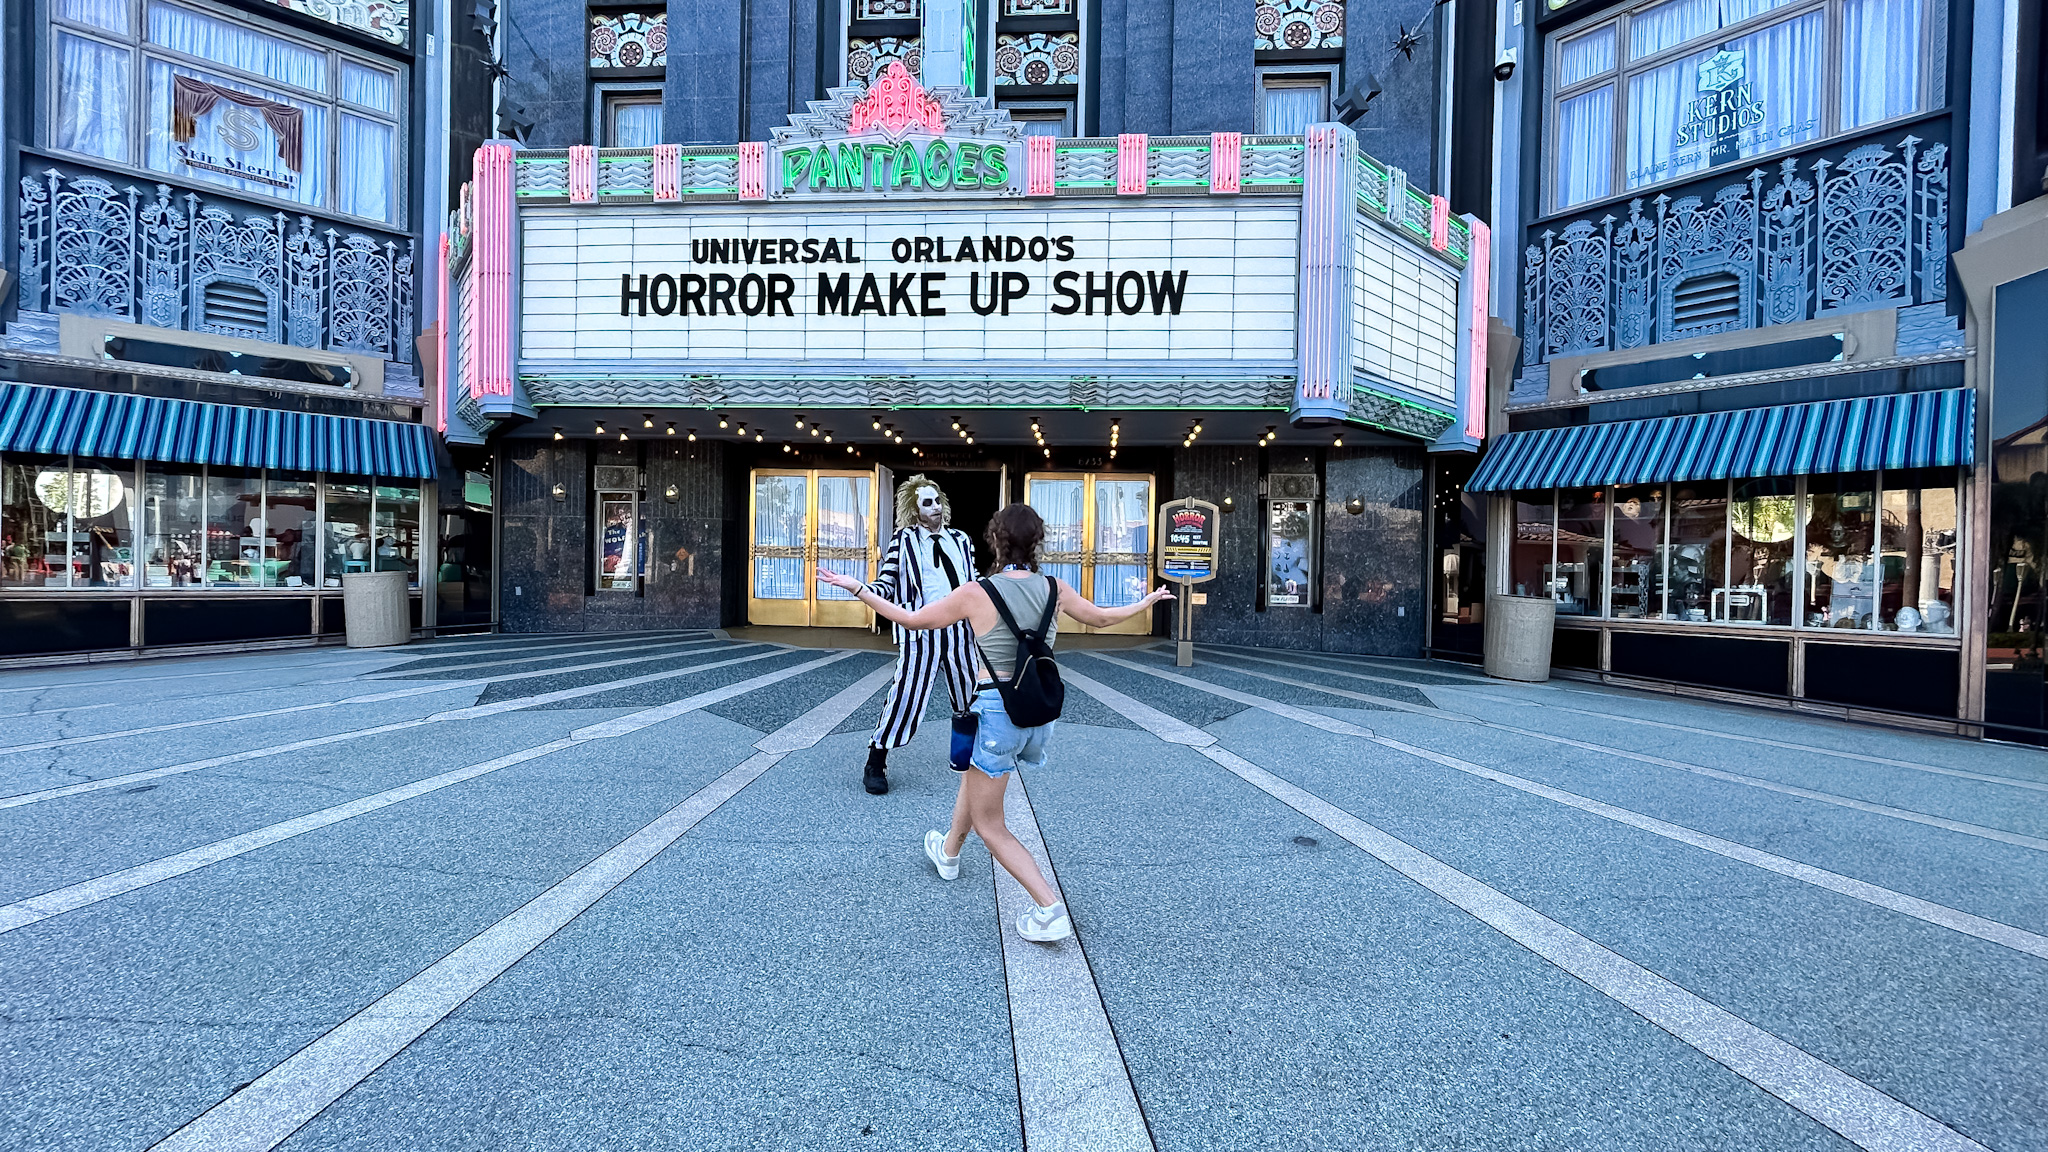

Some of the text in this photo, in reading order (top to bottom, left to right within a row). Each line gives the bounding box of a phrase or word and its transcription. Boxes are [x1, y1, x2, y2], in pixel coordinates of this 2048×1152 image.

[1687, 81, 1754, 124] KERN
[1676, 100, 1766, 148] STUDIOS
[175, 145, 299, 184] Skip Sherman
[782, 139, 1010, 192] PANTAGES
[1630, 161, 1668, 180] BLAINE
[1672, 151, 1702, 168] KERN
[1736, 130, 1773, 150] MARDI
[692, 235, 1075, 264] UNIVERSAL ORLANDO'S
[621, 270, 1188, 317] HORROR MAKE UP SHOW
[1170, 533, 1190, 544] 10:45
[1172, 511, 1206, 525] HORROR
[604, 535, 626, 543] WOLF
